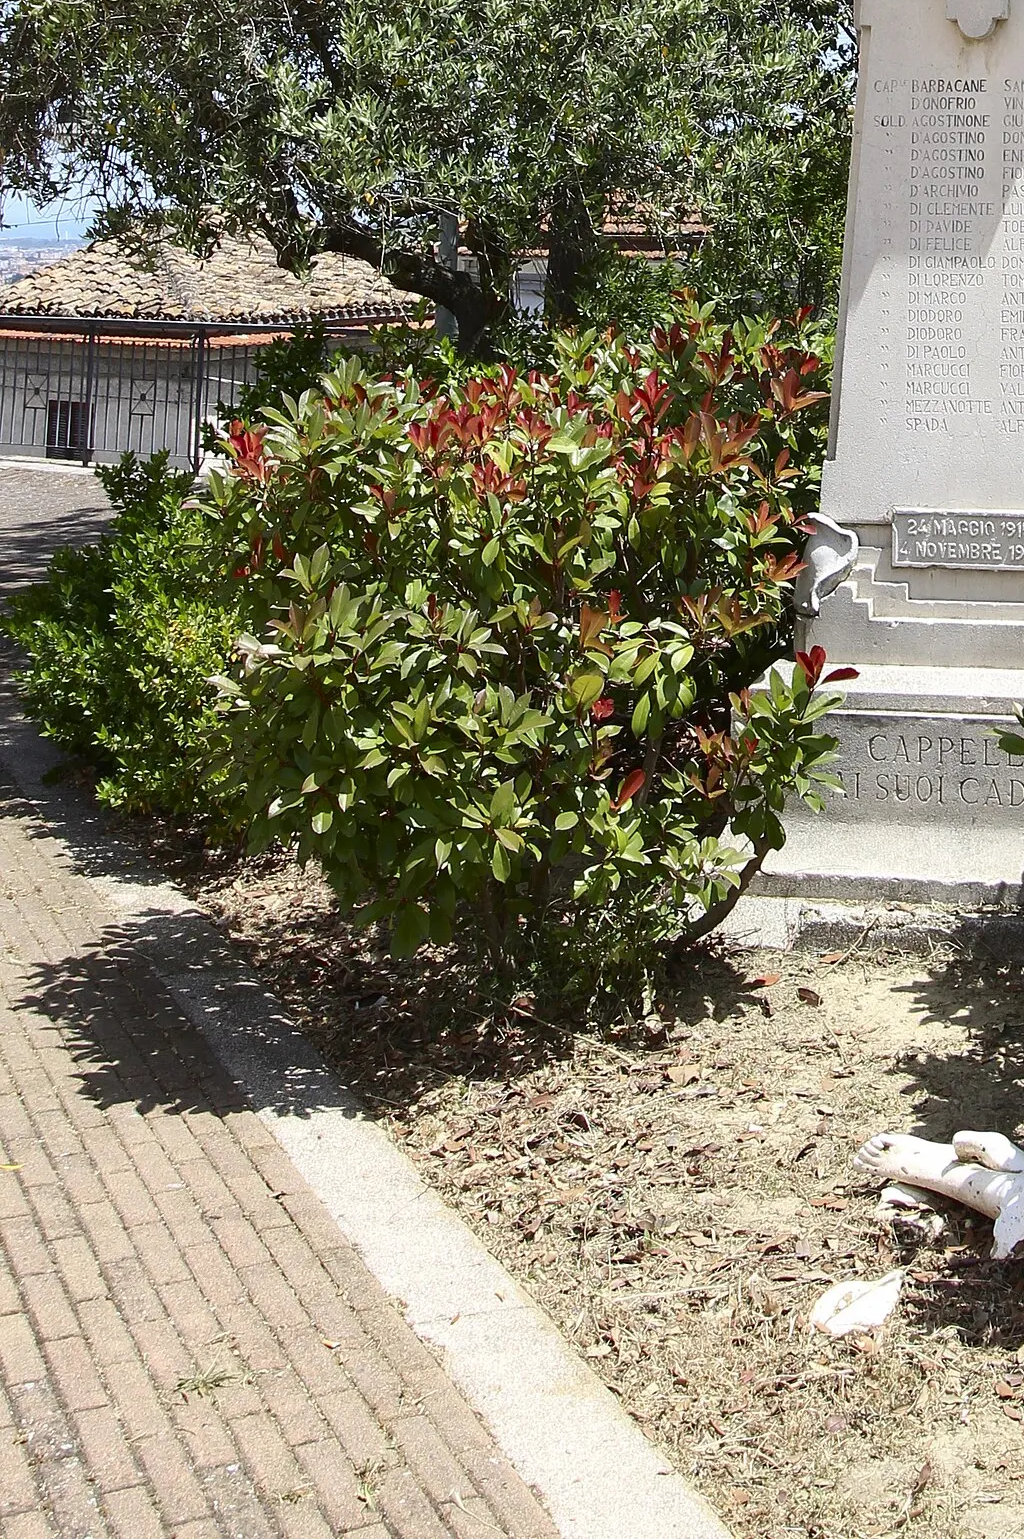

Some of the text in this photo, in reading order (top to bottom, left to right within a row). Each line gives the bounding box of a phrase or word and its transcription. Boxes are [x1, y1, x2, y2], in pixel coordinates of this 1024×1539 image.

[912, 79, 987, 93] BARBACANE
[912, 115, 990, 127] AGOSTINONE
[911, 132, 985, 144] D'AGOSTINO
[911, 149, 985, 162] D'AGOSTINO
[911, 167, 984, 179] D'AGOSTINO
[910, 185, 978, 197] D'ARCHIVIO
[910, 203, 921, 215] DI
[927, 203, 994, 215] CLEMENTE
[910, 220, 920, 233] DI
[927, 220, 972, 233] DAVIDE
[910, 238, 920, 250] DI
[926, 238, 972, 250] FELICE
[909, 256, 920, 269] DI
[925, 256, 995, 269] GIAMPAOLO
[908, 274, 920, 286] DI
[925, 274, 984, 287] LORENZO
[908, 291, 920, 304] DI
[924, 292, 966, 304] MARCO
[908, 310, 962, 323] DIODORO
[907, 327, 961, 340] DIODORO
[907, 346, 919, 358] DI
[924, 346, 965, 359] PAOLO
[907, 364, 970, 377] MARCUCCI
[906, 382, 969, 395] MARCUCCI
[906, 400, 992, 414] MEZZANOTTE
[905, 418, 948, 431] SPADA
[907, 519, 928, 534] 24
[932, 519, 995, 536] MAGGIO
[915, 541, 1002, 560] NOVEMBRE
[876, 774, 943, 804] SUOI
